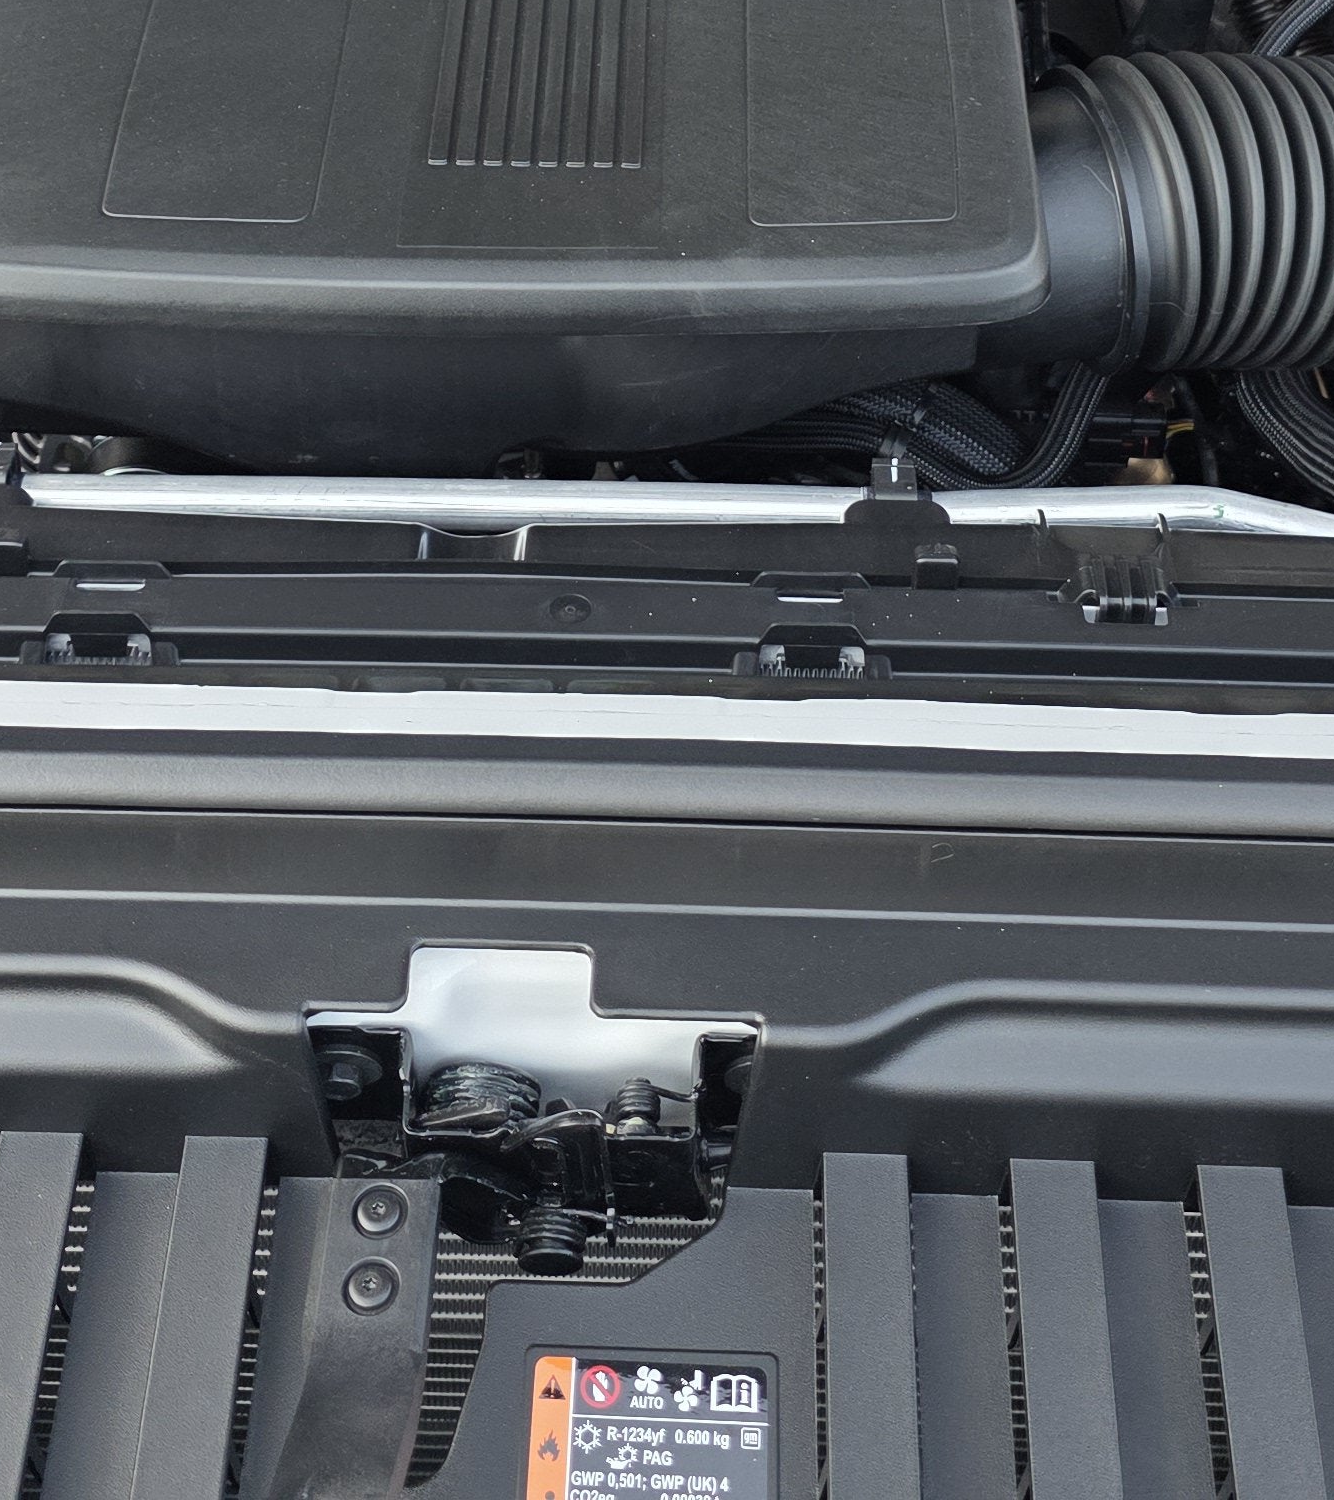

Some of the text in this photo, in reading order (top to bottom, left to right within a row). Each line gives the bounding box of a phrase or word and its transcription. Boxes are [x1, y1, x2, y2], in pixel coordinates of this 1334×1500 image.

[630, 1396, 663, 1409] AUTO
[607, 1426, 730, 1449] R-1234yf 0.600 kg
[643, 1450, 673, 1466] PAG
[571, 1471, 729, 1495] GWP 0,501; GWP (UK) 4
